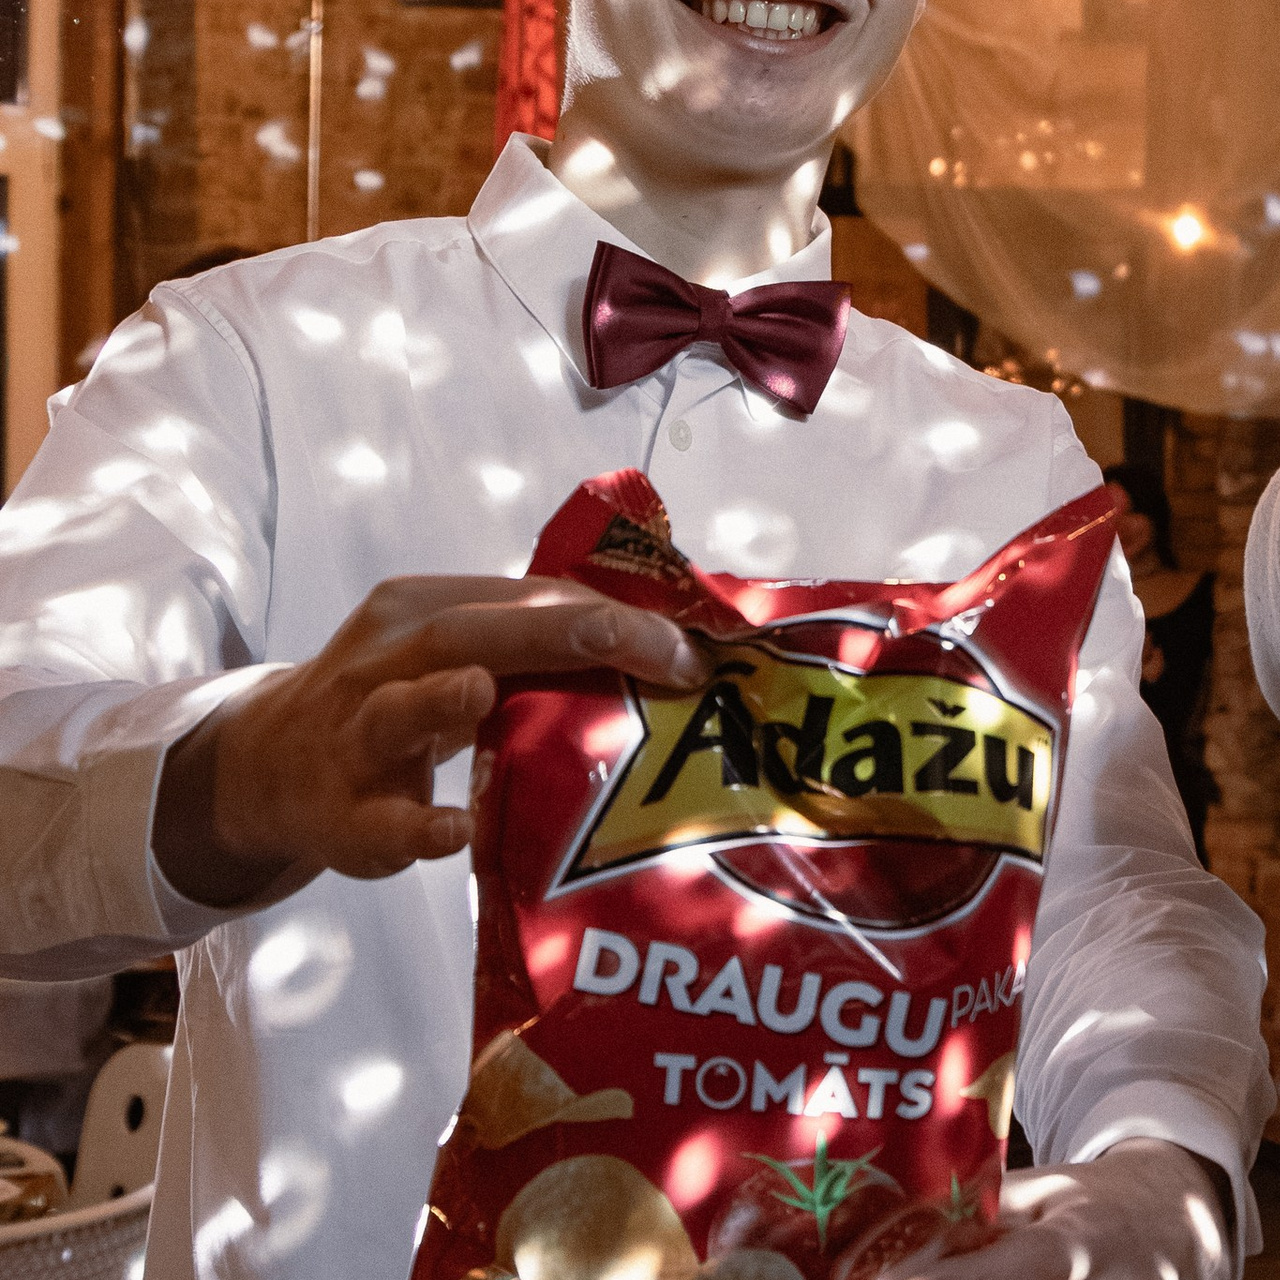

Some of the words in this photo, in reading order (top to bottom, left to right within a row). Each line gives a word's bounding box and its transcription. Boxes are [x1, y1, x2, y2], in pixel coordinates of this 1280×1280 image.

[641, 661, 1034, 811] Ādažu
[573, 927, 948, 1058] DRAUGU
[654, 1051, 936, 1120] TOMĀTS
